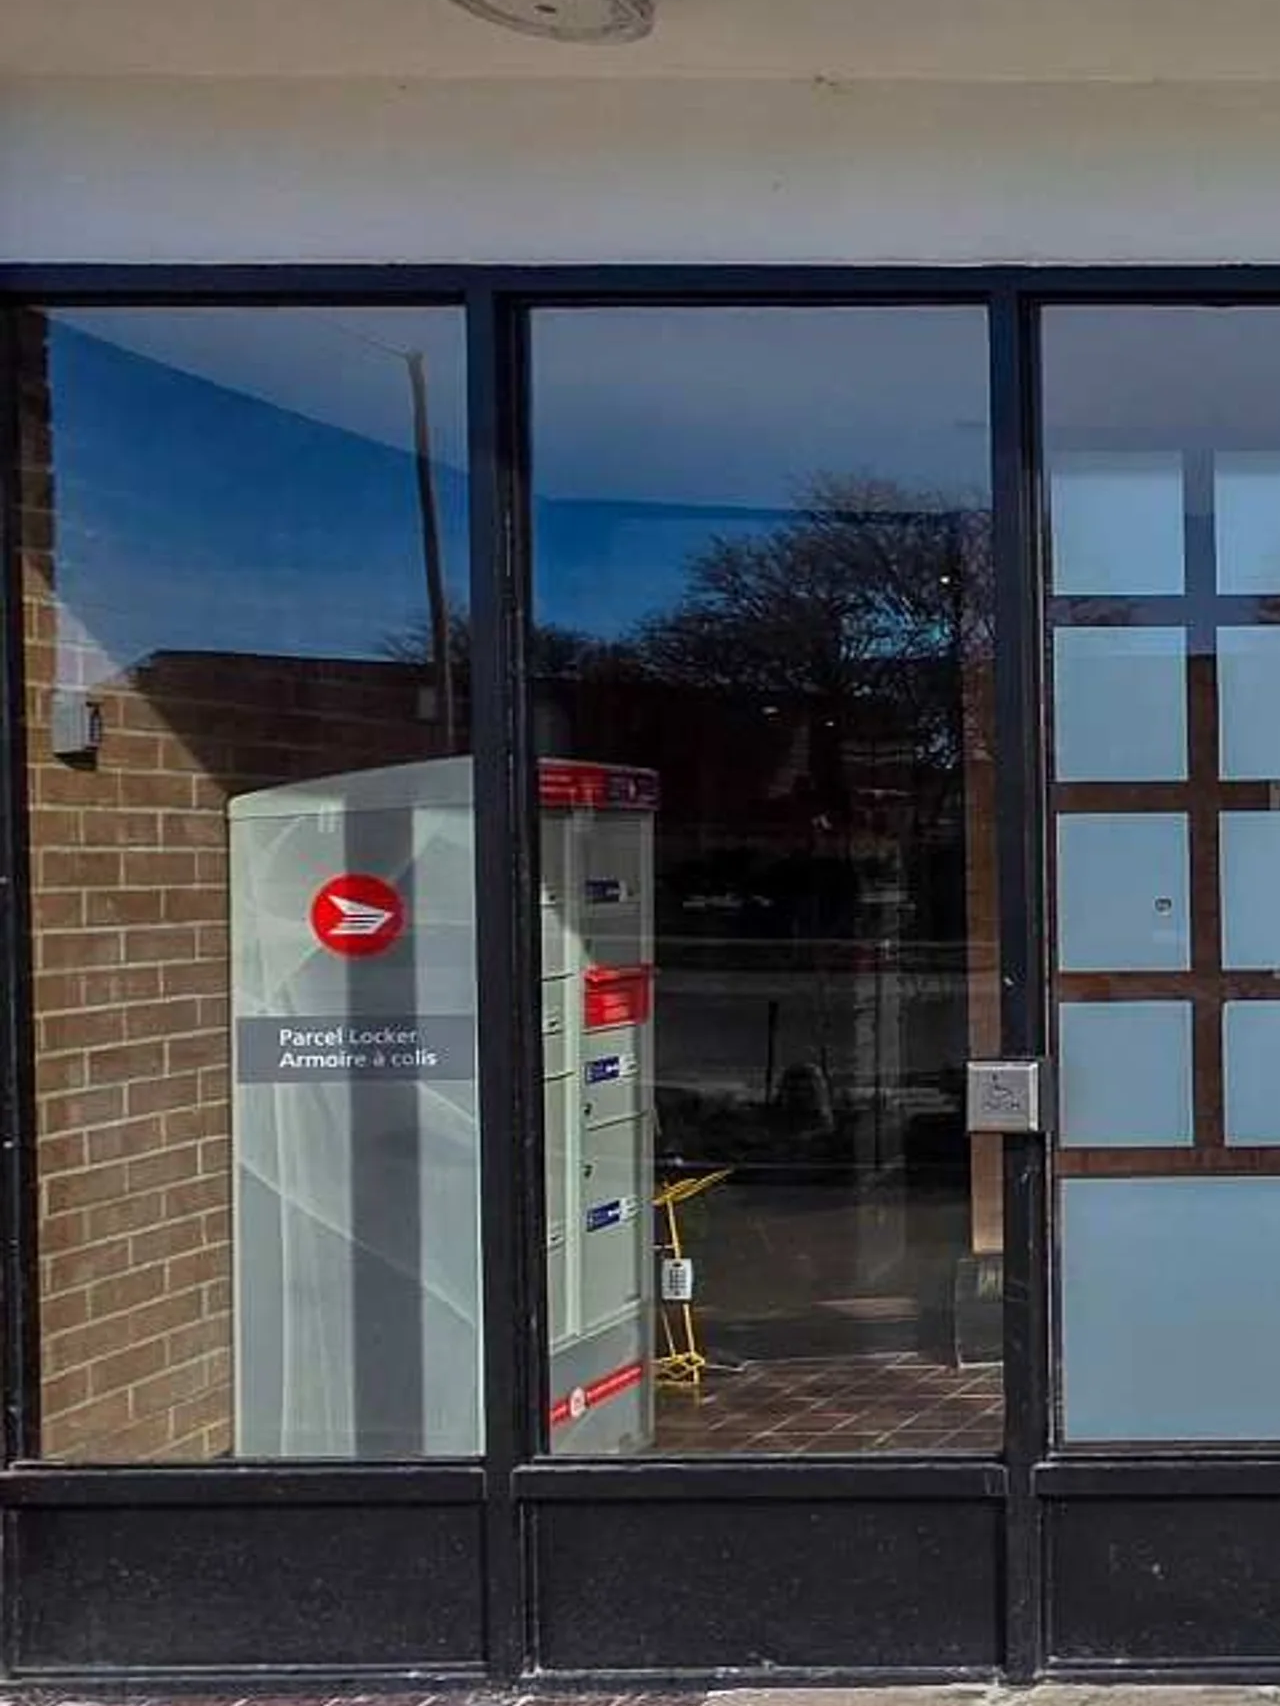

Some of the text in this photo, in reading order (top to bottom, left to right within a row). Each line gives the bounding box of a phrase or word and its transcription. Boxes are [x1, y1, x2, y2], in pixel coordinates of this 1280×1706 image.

[279, 1027, 418, 1046] Parcel Locker
[279, 1051, 366, 1068] Armoire
[391, 1049, 437, 1066] colis
